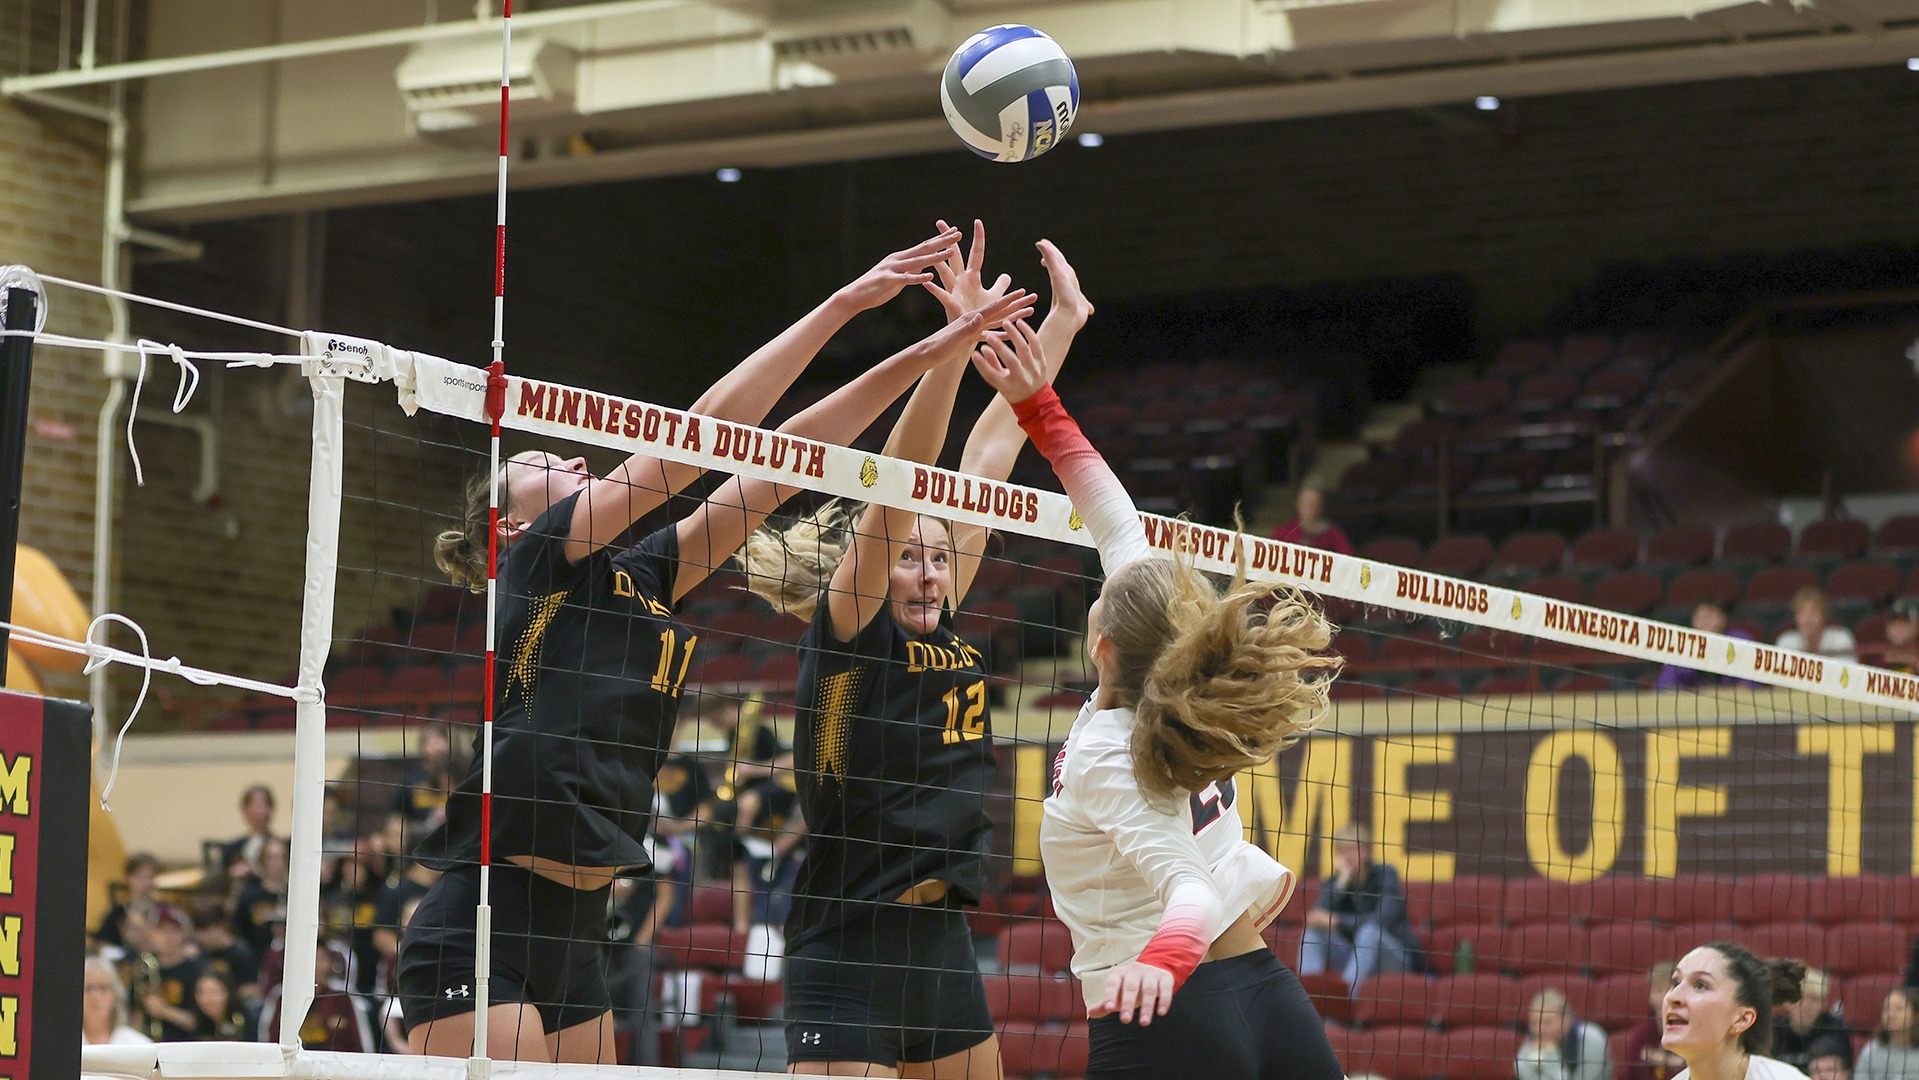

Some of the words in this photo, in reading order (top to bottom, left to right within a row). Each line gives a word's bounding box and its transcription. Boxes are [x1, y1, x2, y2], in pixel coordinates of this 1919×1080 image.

[338, 341, 368, 356] Senoh
[516, 380, 702, 453] MINNESOTA
[711, 422, 827, 480] DULUTH
[910, 466, 1039, 524] BULLDOGS
[1251, 540, 1334, 583] DULUTH
[1396, 571, 1489, 614] BULLDOGS
[1544, 602, 1640, 645] MINNESOTA
[1646, 625, 1708, 660] DULUTH
[650, 628, 698, 699] 11
[1754, 648, 1824, 684] BULLDOGS
[942, 680, 985, 745] 12
[1524, 727, 1733, 884] OF
[1797, 722, 1919, 878] T
